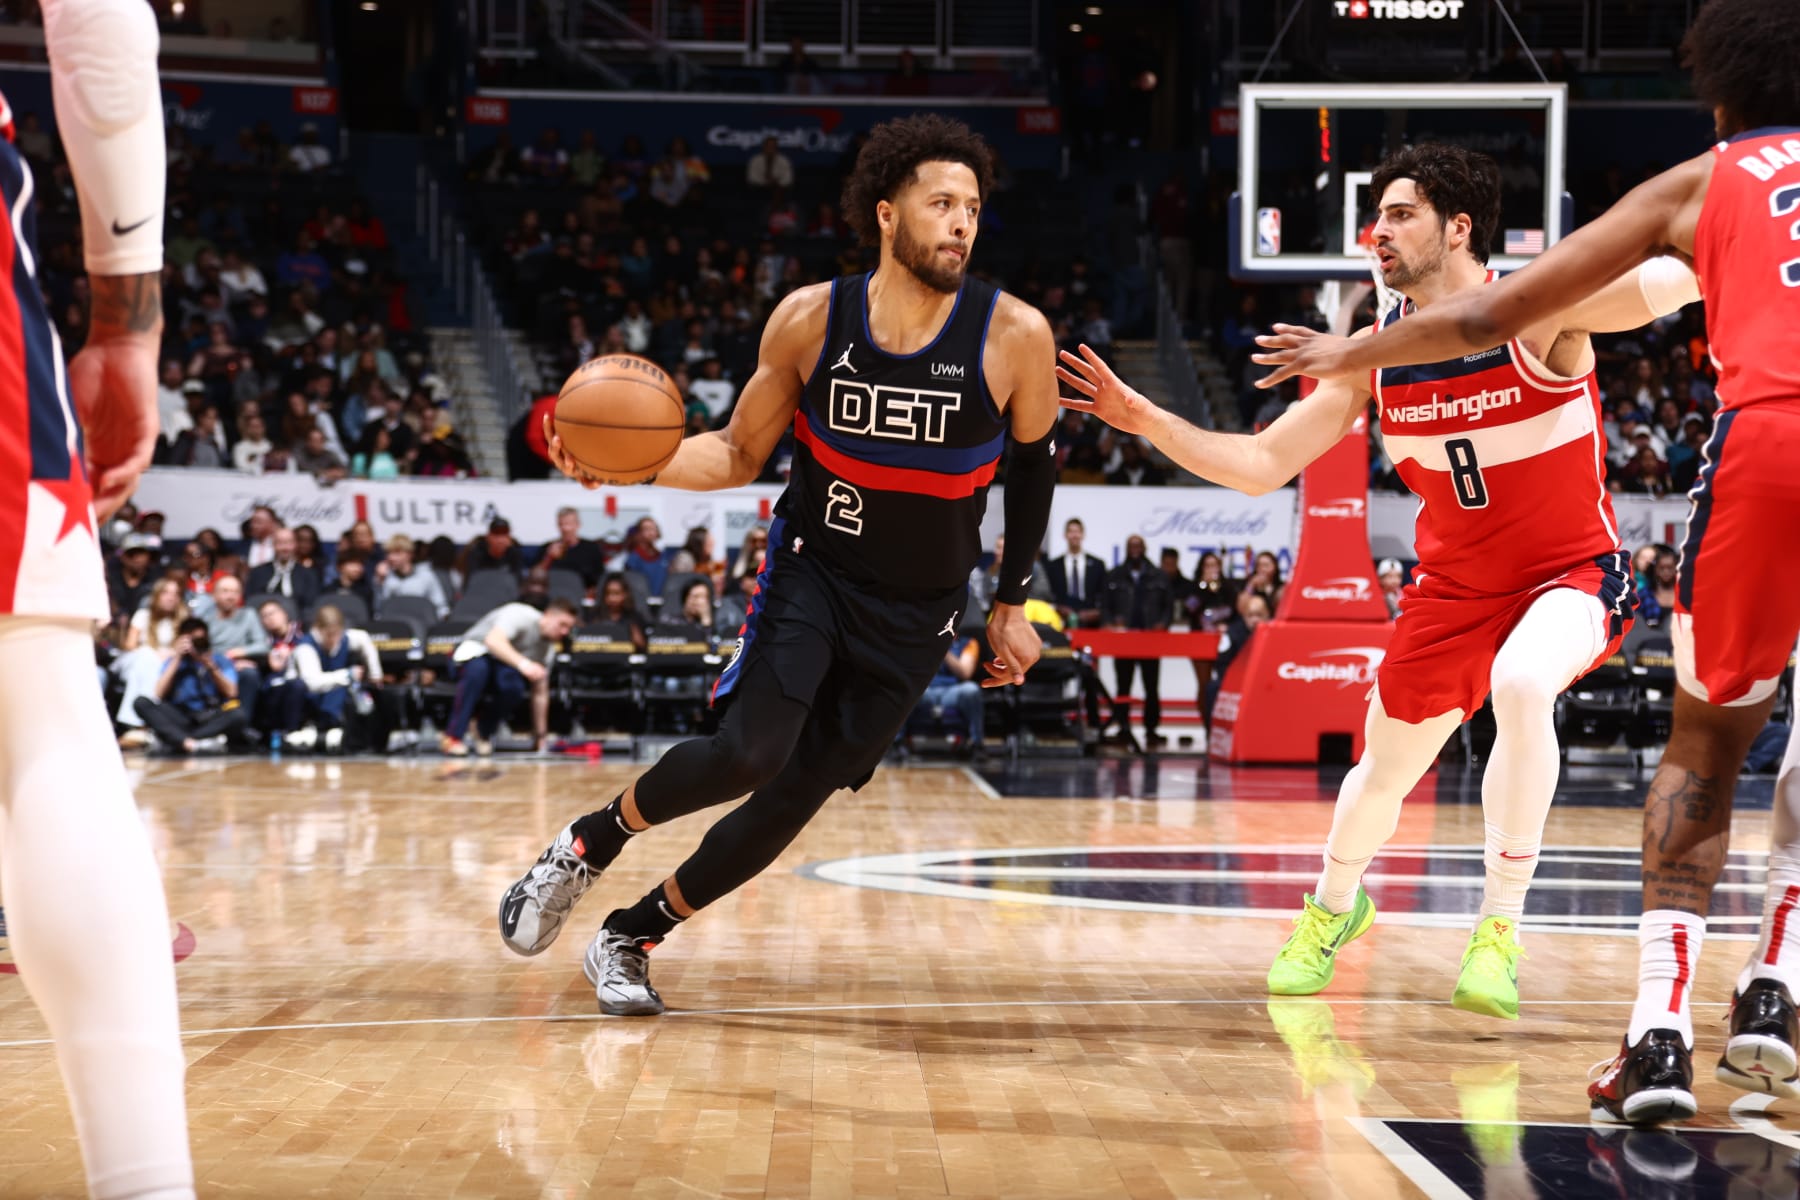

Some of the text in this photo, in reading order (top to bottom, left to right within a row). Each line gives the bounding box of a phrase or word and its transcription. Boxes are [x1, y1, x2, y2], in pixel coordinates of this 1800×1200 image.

[1369, 0, 1464, 19] TISSOT
[931, 362, 964, 378] UWM
[1464, 348, 1502, 364] Robinhood
[829, 378, 962, 443] DET
[1386, 386, 1522, 423] washington
[1444, 437, 1489, 510] 8
[824, 480, 863, 537] 2
